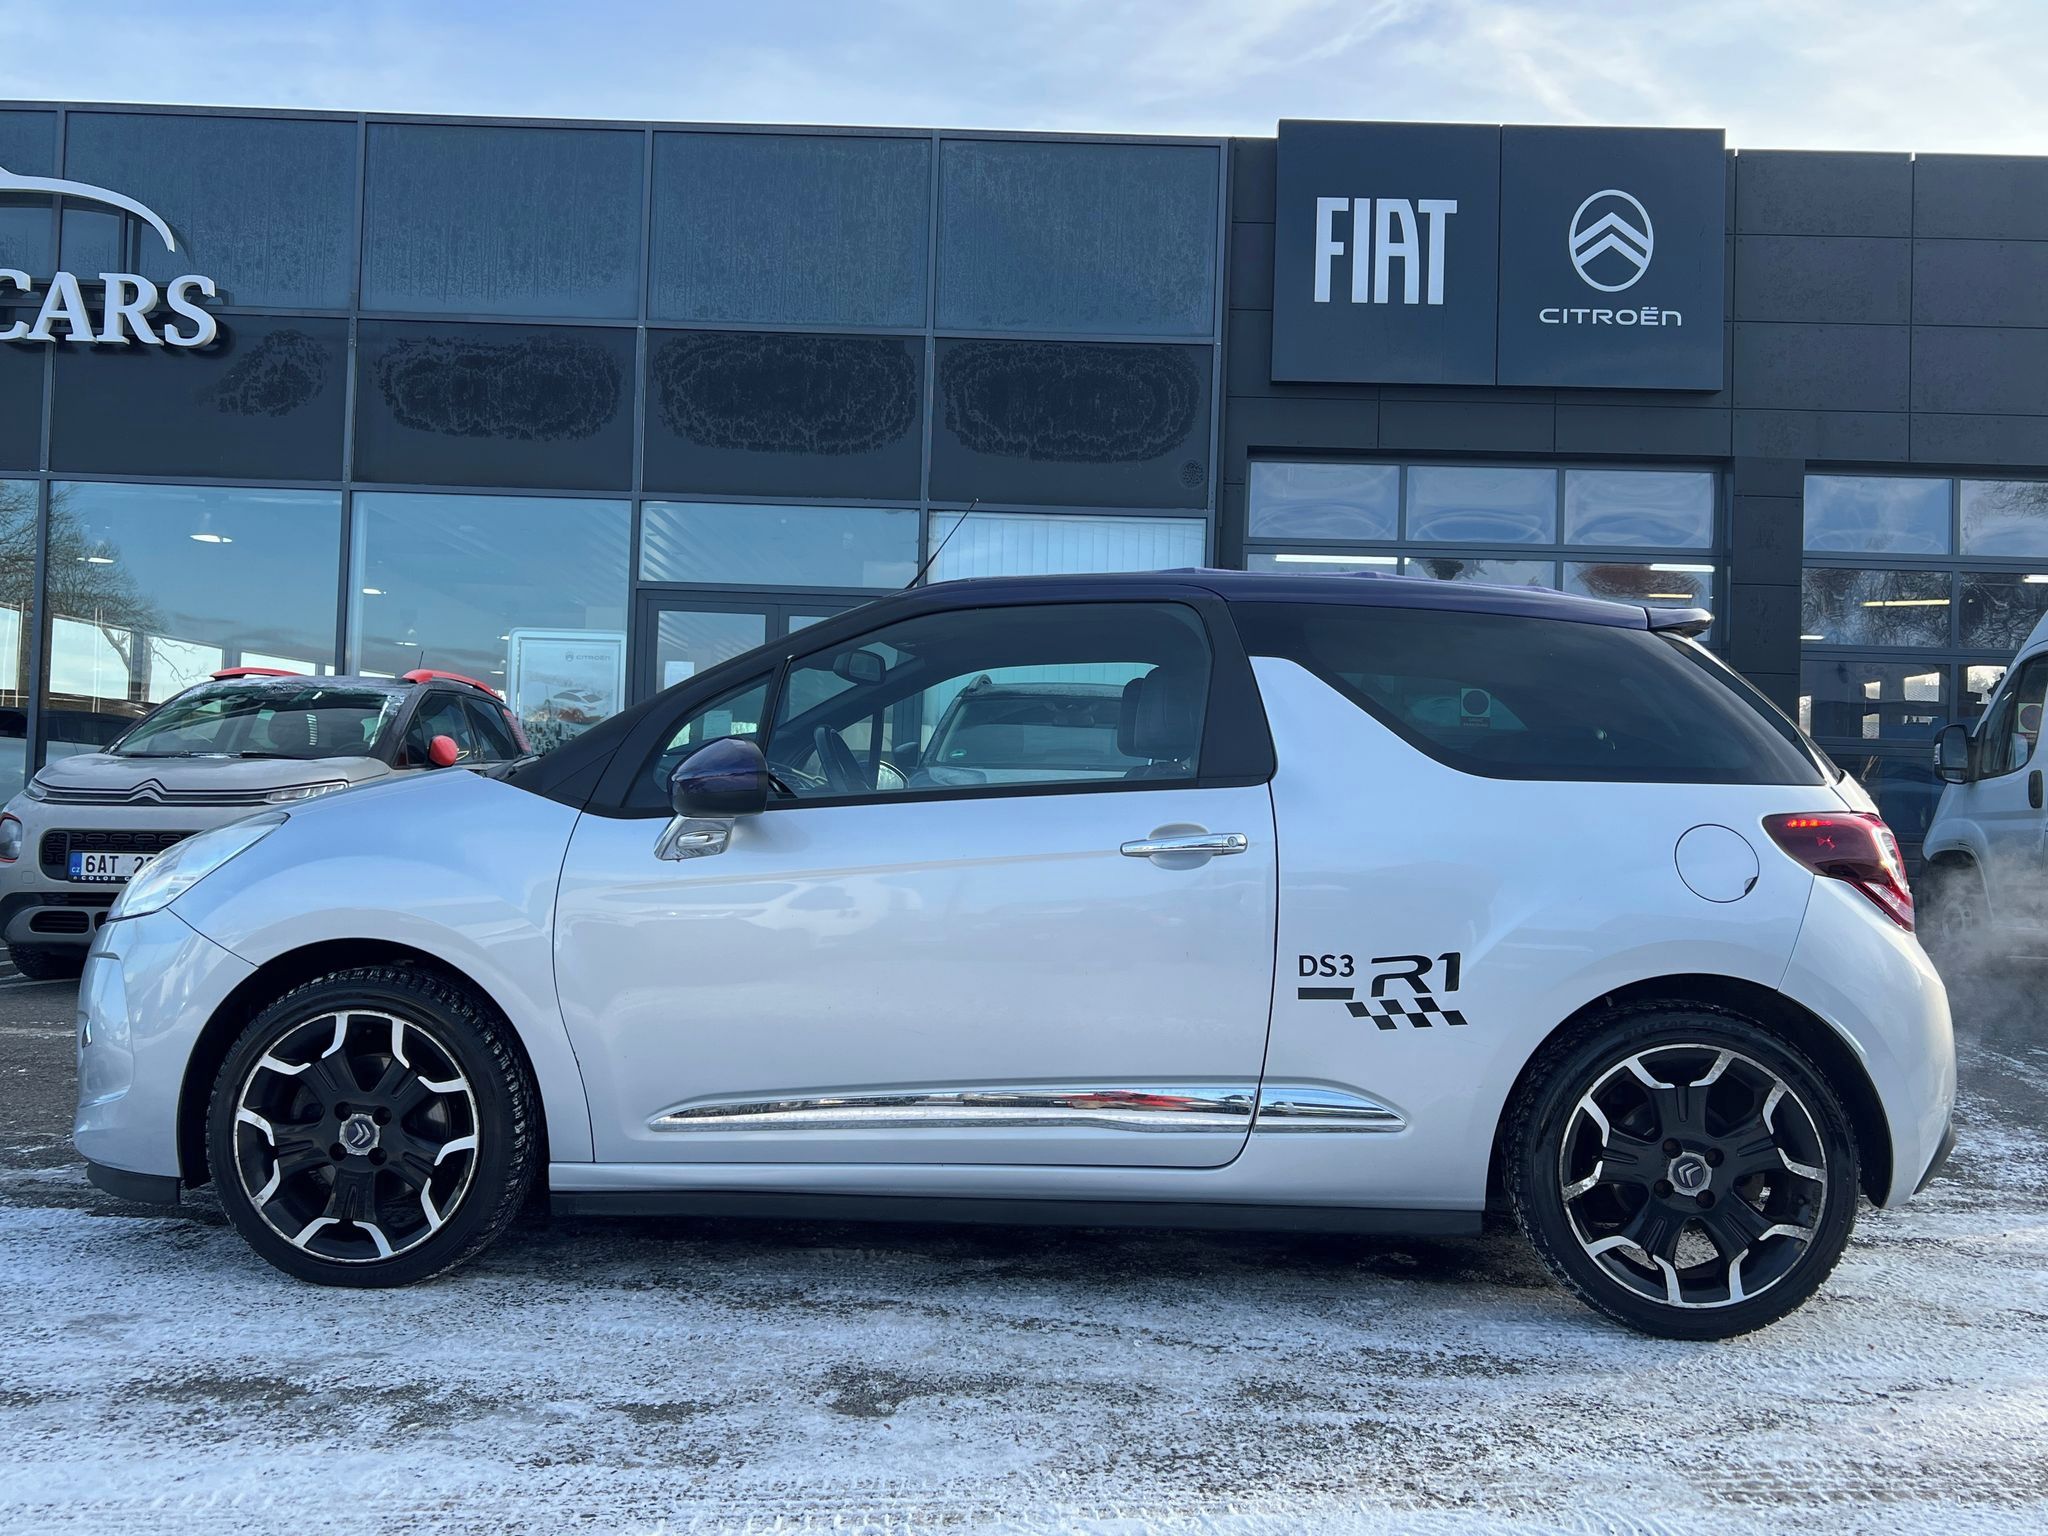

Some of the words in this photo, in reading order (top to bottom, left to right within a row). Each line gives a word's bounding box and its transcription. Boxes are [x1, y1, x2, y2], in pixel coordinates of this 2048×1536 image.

[1313, 196, 1458, 305] FIAT
[85, 855, 119, 873] 6AT
[134, 856, 154, 874] 2
[1299, 954, 1355, 977] DS3
[1370, 952, 1461, 998] R1
